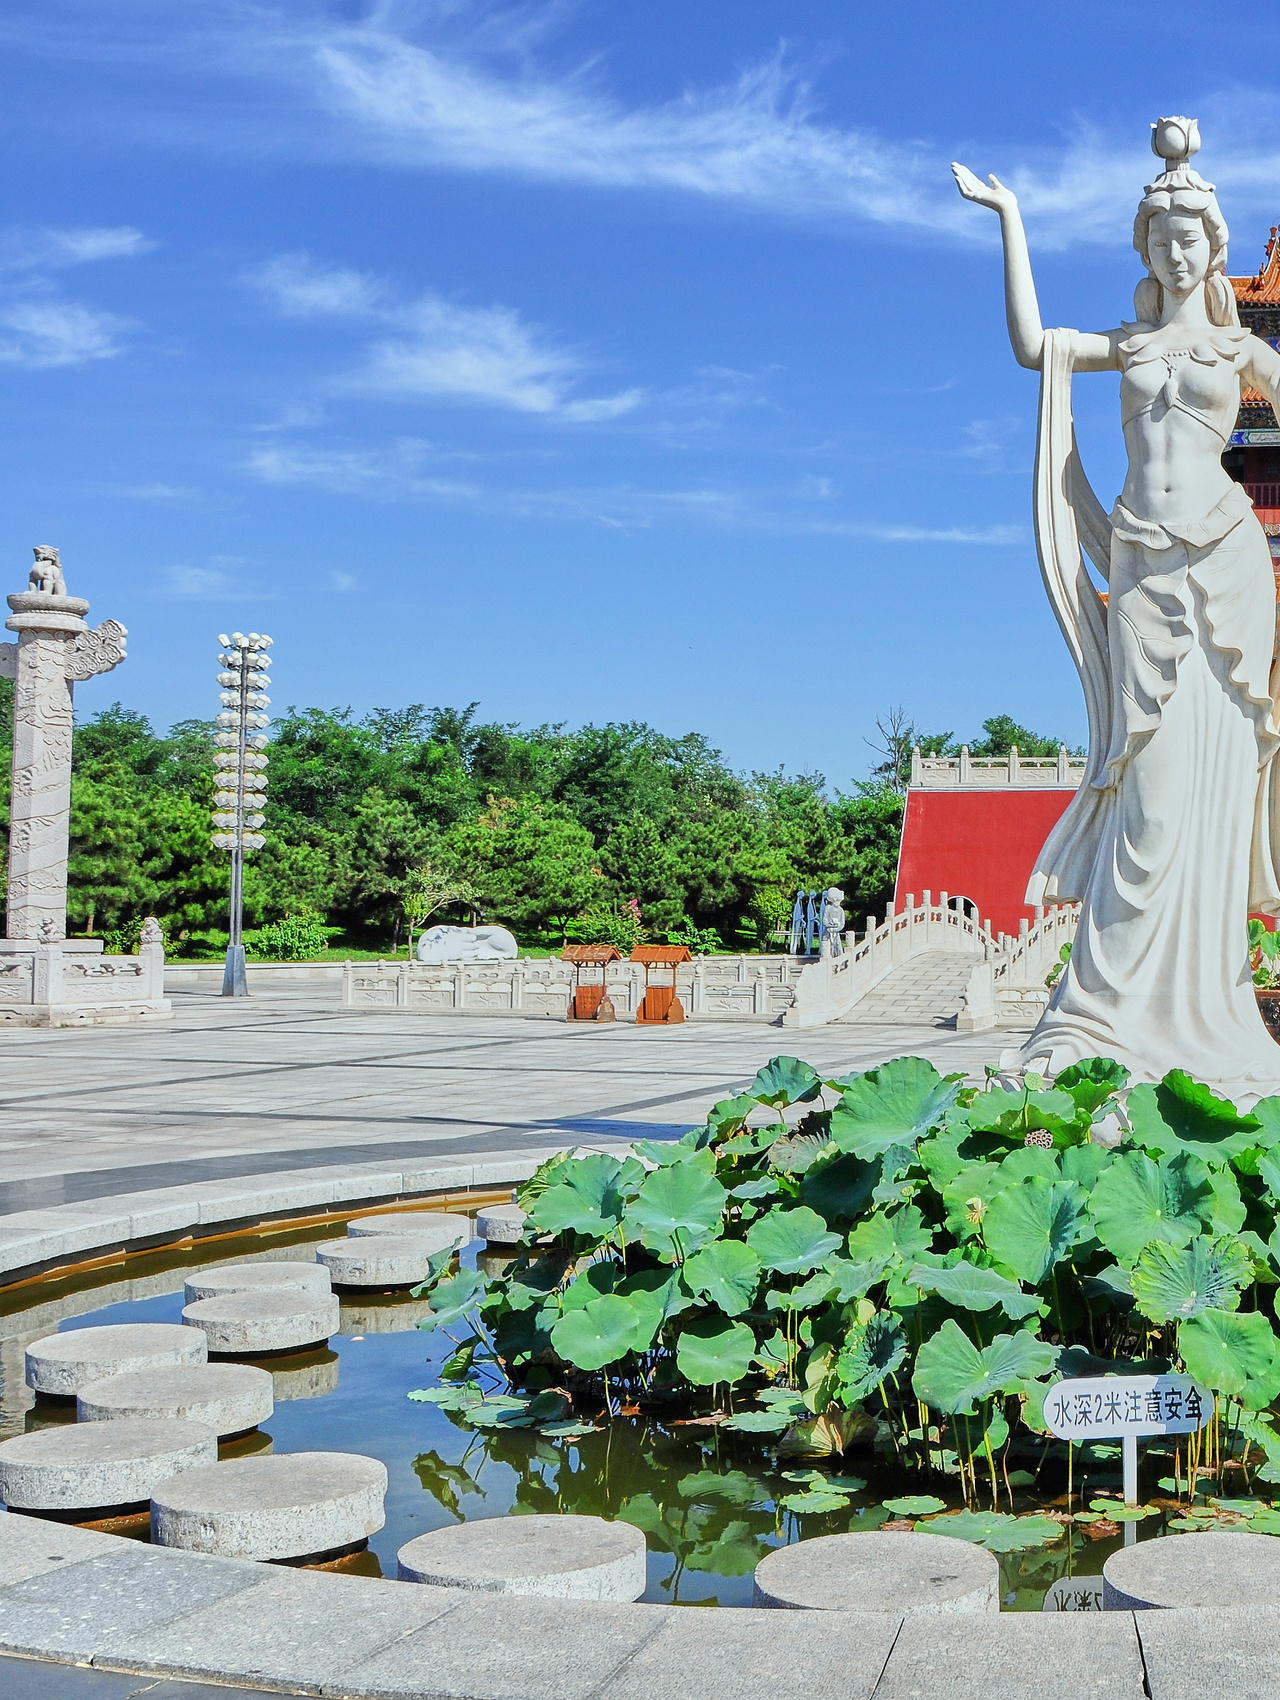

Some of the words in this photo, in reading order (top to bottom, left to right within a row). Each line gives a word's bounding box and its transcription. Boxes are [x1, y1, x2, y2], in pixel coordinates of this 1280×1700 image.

[1053, 1385, 1203, 1428] 水深2米注意安全
